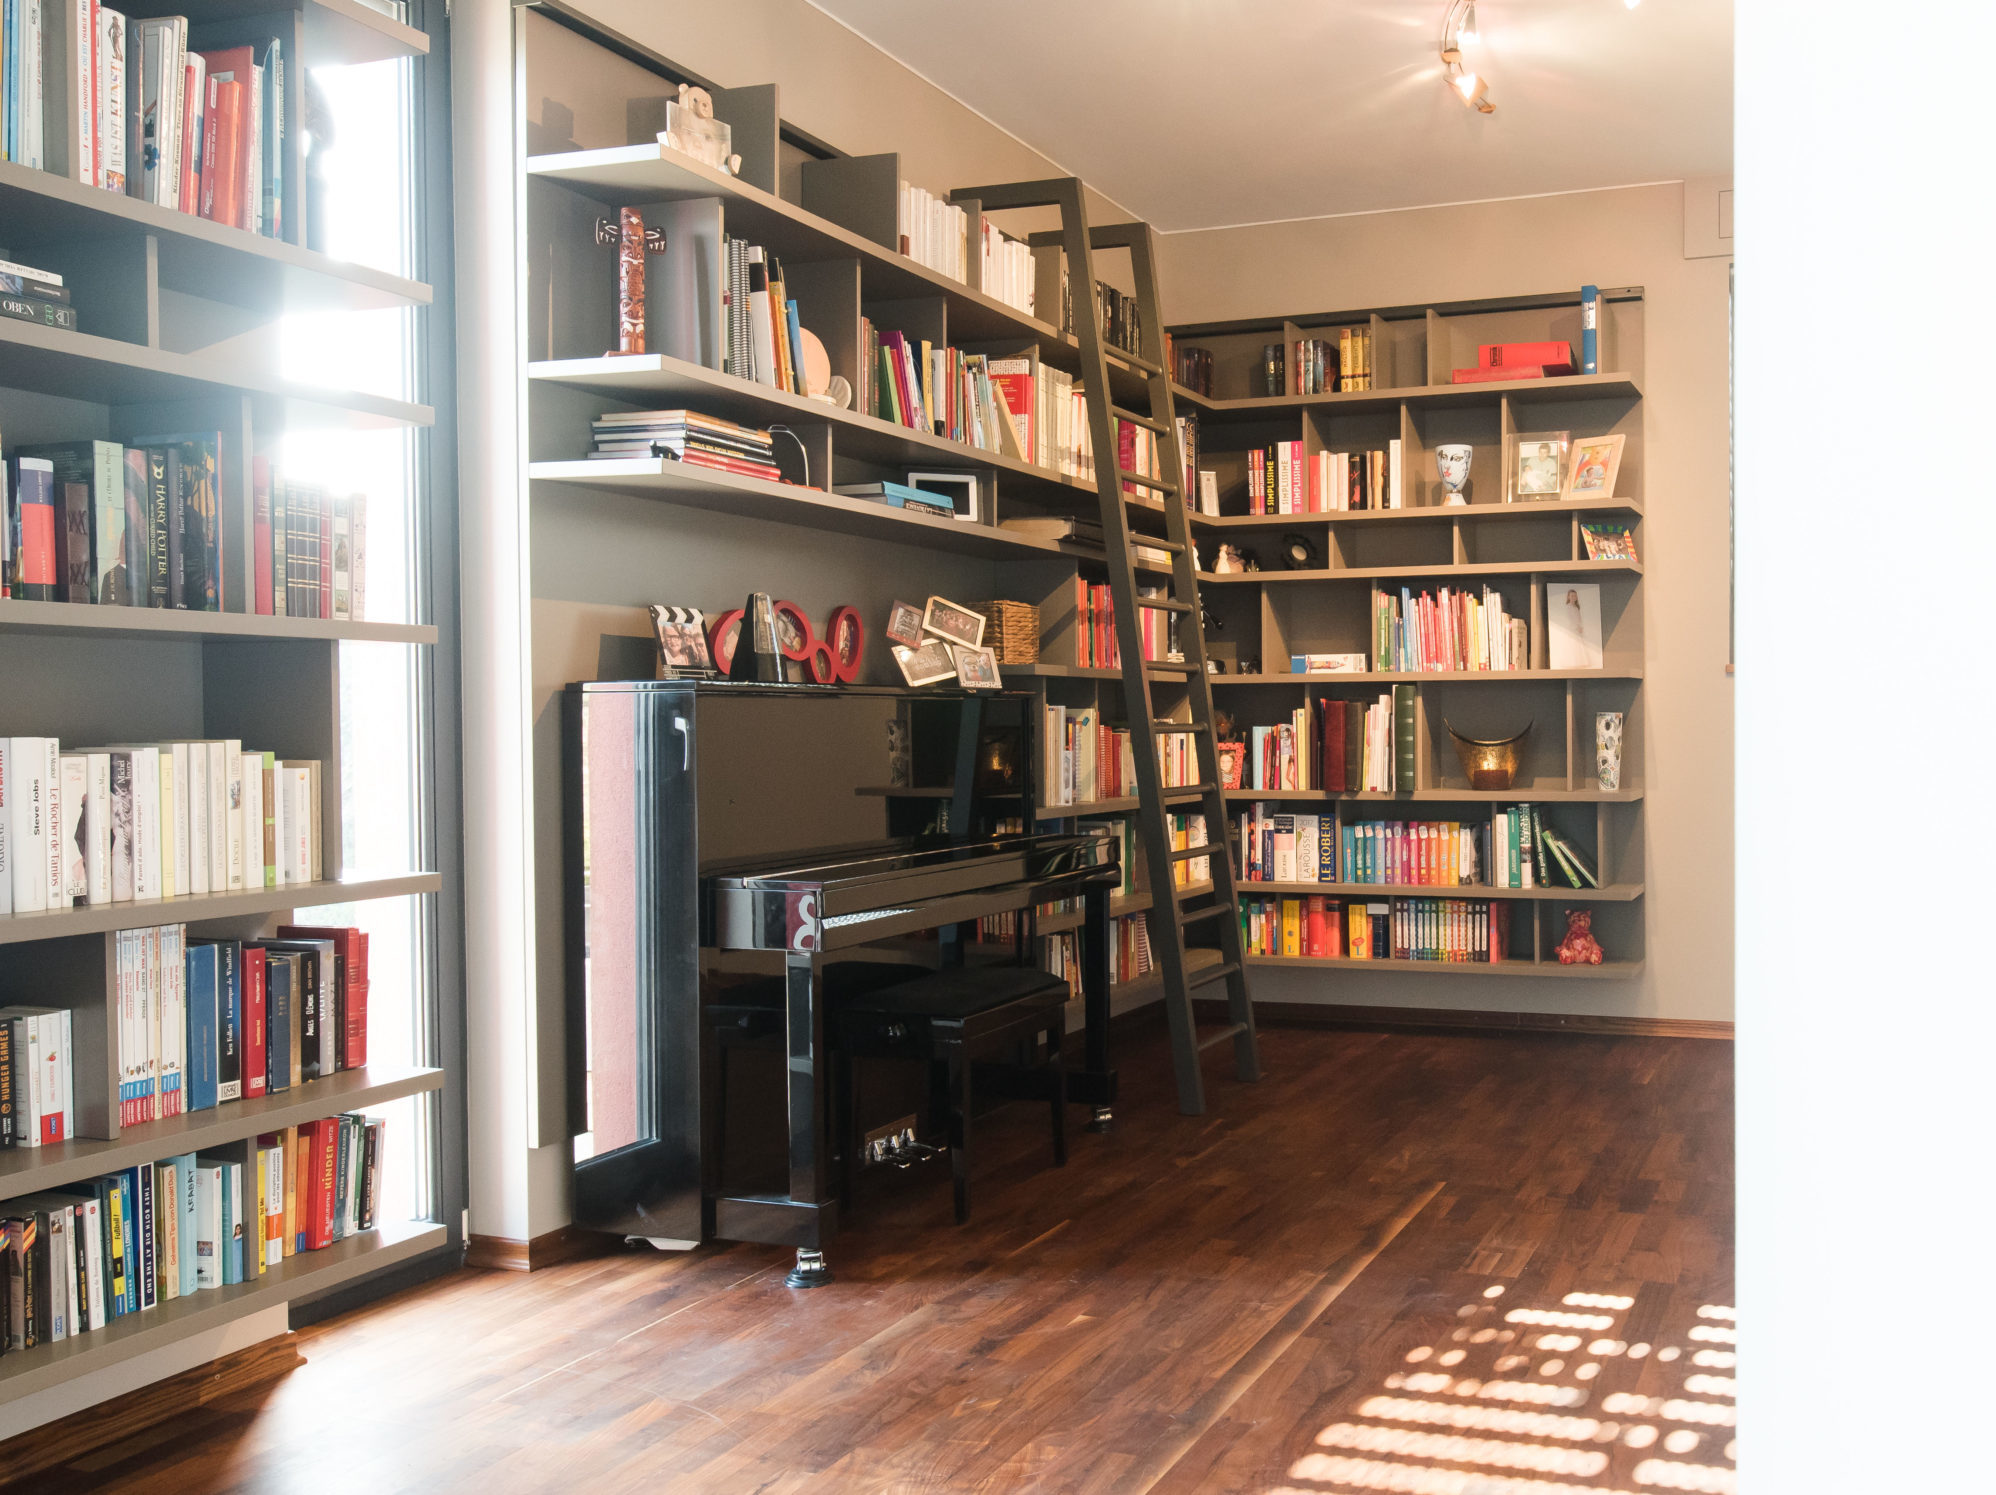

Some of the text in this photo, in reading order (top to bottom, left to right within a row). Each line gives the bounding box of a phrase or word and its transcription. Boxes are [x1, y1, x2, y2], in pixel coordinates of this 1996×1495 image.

[110, 61, 122, 166] WAS IST KUNST
[3, 300, 34, 316] OBEN
[1281, 460, 1289, 504] SIMPLISSIME
[156, 485, 167, 576] HARRY POTTER
[117, 760, 125, 784] Michel
[50, 788, 59, 799] Le
[50, 803, 59, 836] Rocher
[51, 840, 59, 851] de
[1303, 833, 1311, 879] LAROUSSE
[1321, 817, 1331, 881] LE ROBERT
[51, 855, 60, 886] Tanios
[227, 977, 232, 985] de
[226, 1010, 232, 1018] La
[306, 1019, 314, 1036] ANGES
[0, 1030, 9, 1060] GAMES
[0, 1064, 10, 1100] HUNGER
[113, 1218, 121, 1239] Fußball
[146, 1249, 151, 1258] AT
